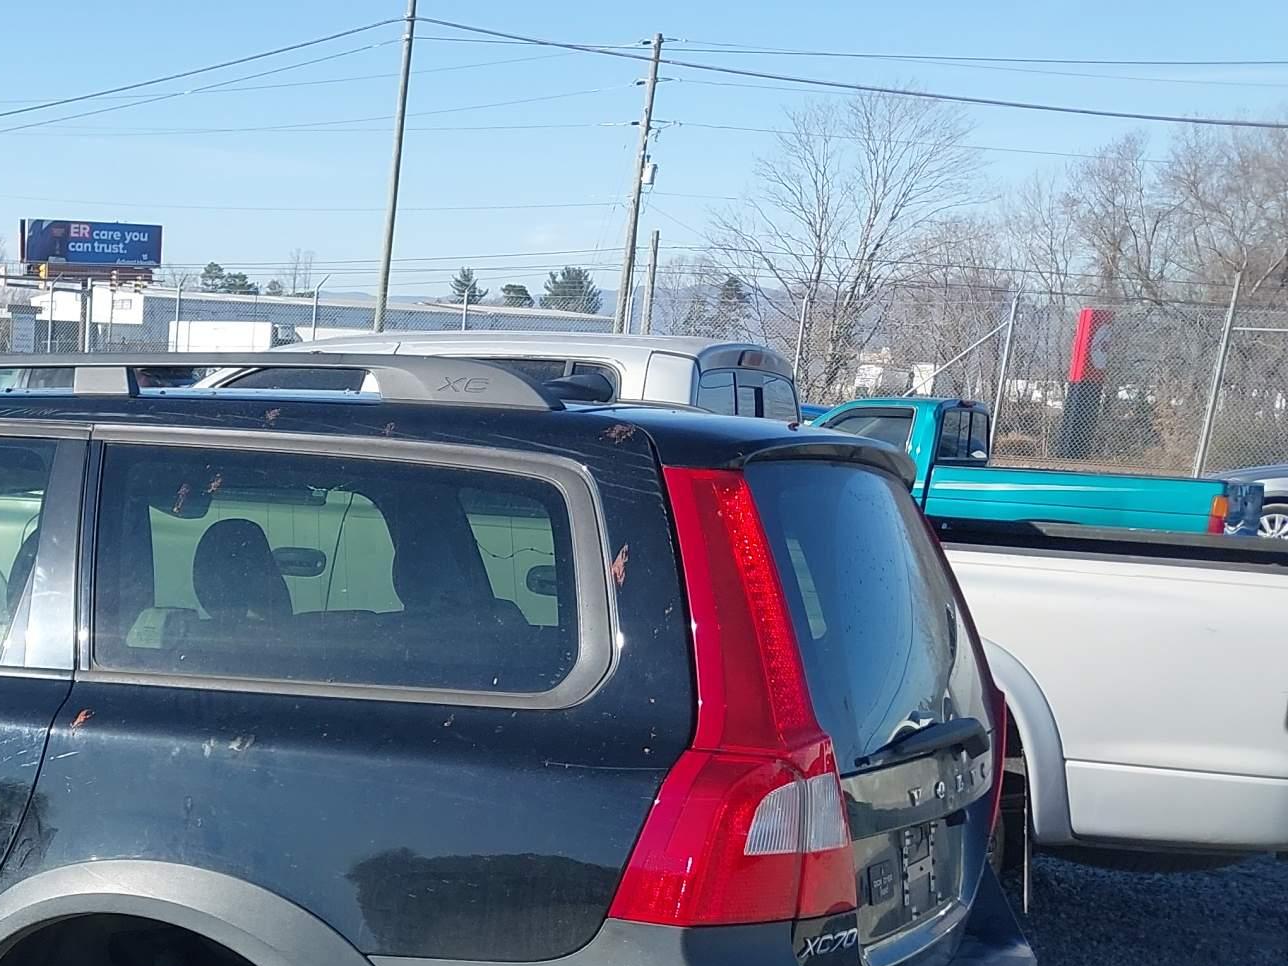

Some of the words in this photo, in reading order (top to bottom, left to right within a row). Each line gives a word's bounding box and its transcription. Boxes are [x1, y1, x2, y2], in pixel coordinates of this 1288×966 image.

[70, 223, 90, 238] ER
[92, 229, 121, 240] care
[124, 231, 149, 244] you
[68, 241, 92, 252] can
[94, 240, 128, 254] trust.
[800, 927, 858, 958] XC70
